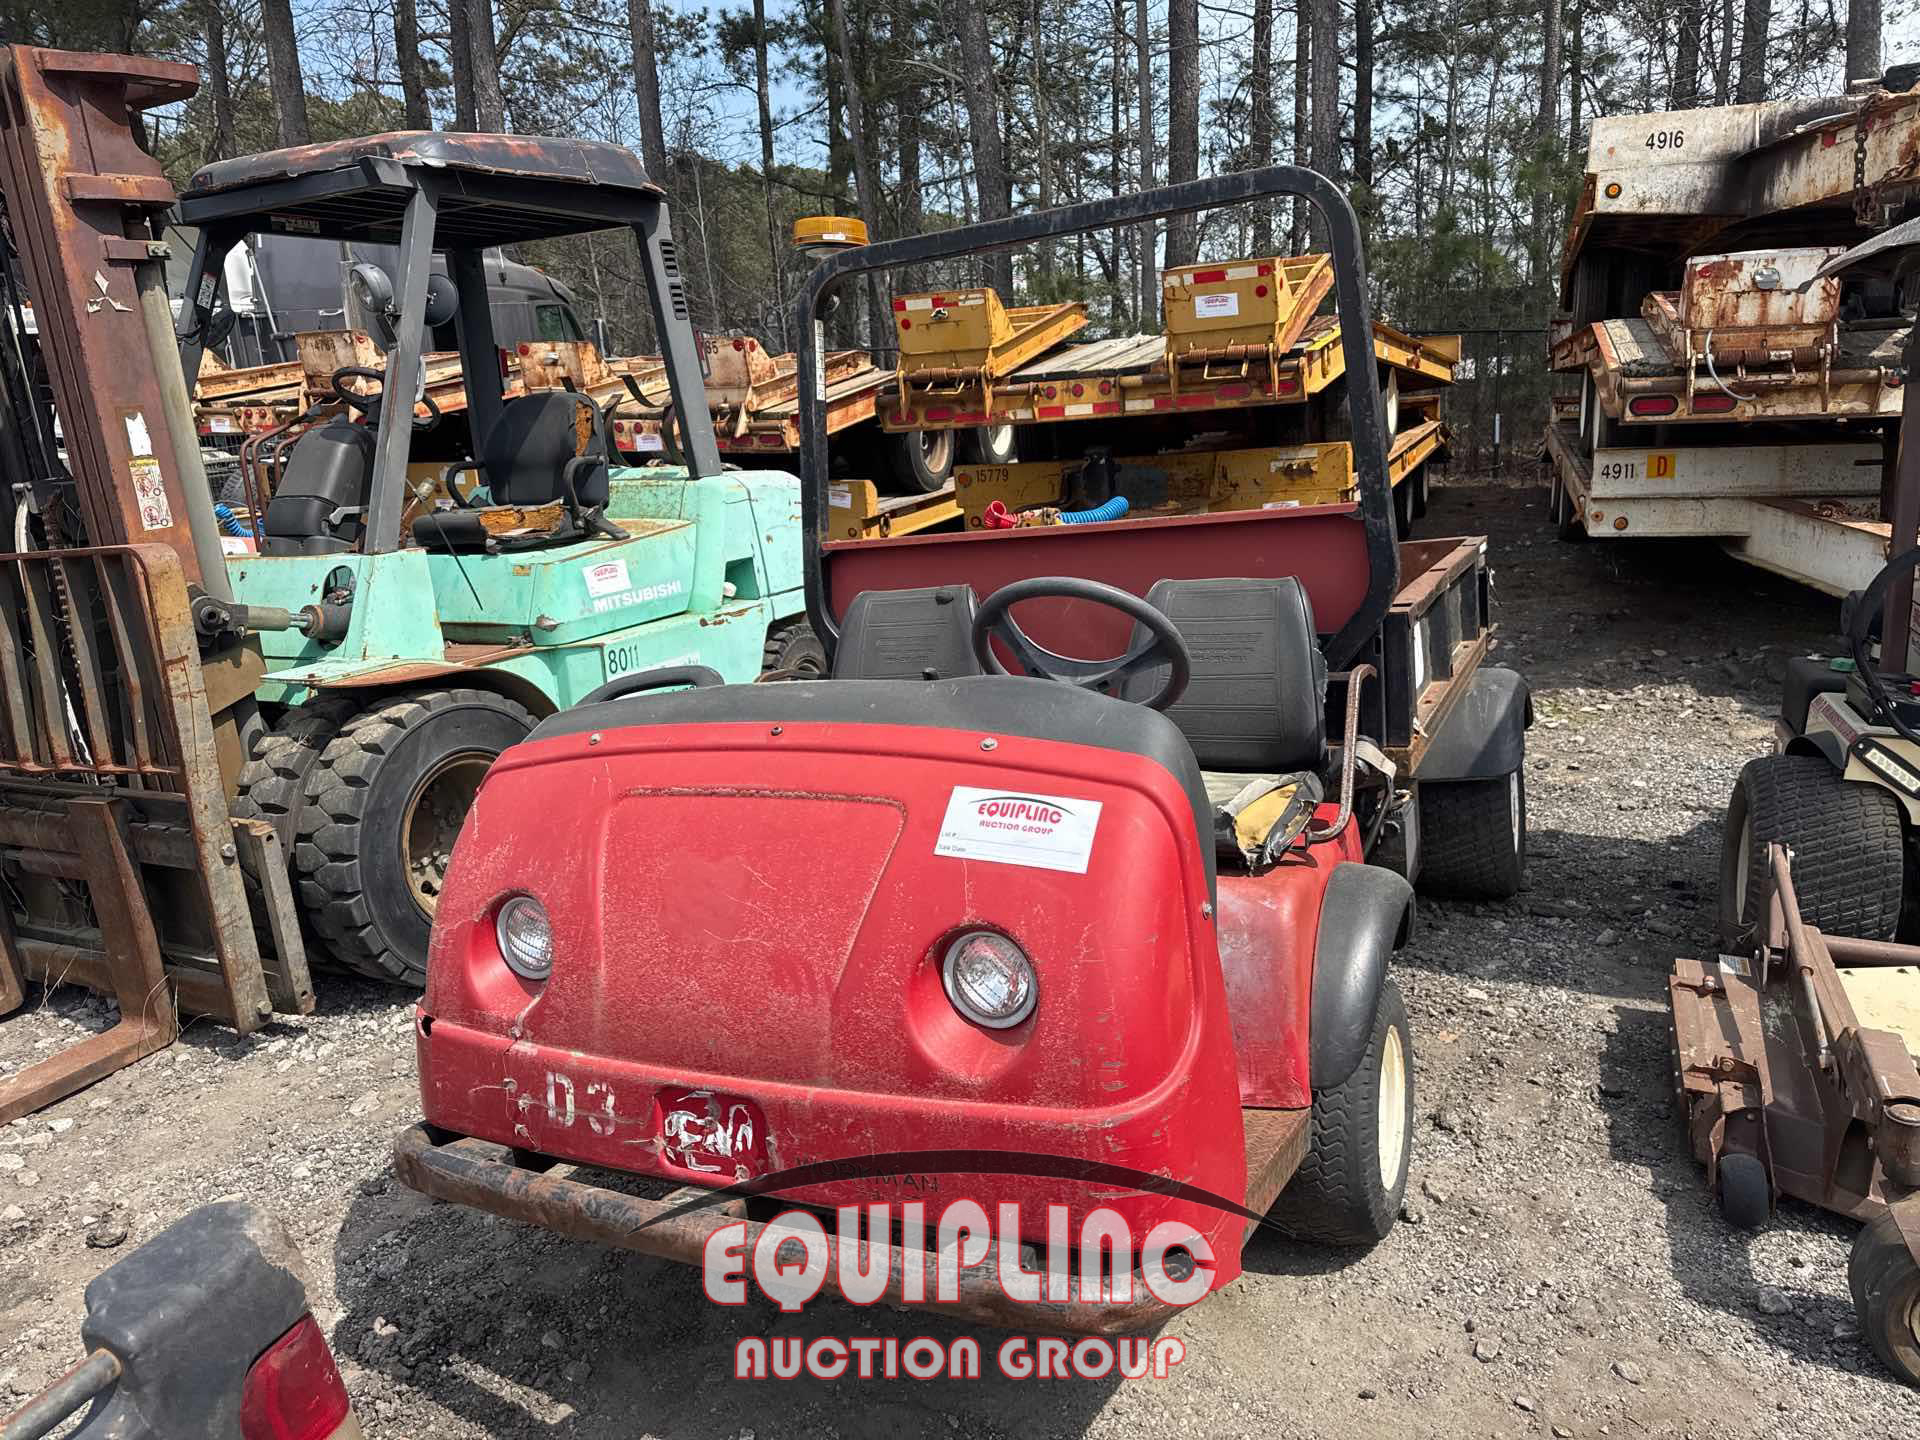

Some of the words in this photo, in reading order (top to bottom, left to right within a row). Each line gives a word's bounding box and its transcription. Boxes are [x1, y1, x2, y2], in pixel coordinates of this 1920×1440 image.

[1645, 130, 1684, 150] 4916
[976, 468, 1008, 482] 15779
[1601, 463, 1634, 479] 4911
[1657, 455, 1668, 477] D
[592, 579, 682, 613] MITSUBISHI
[608, 644, 639, 674] 8011
[977, 801, 1063, 824] EQUIPLINC
[979, 820, 1020, 831] AUCTION
[1021, 824, 1054, 835] GROUP
